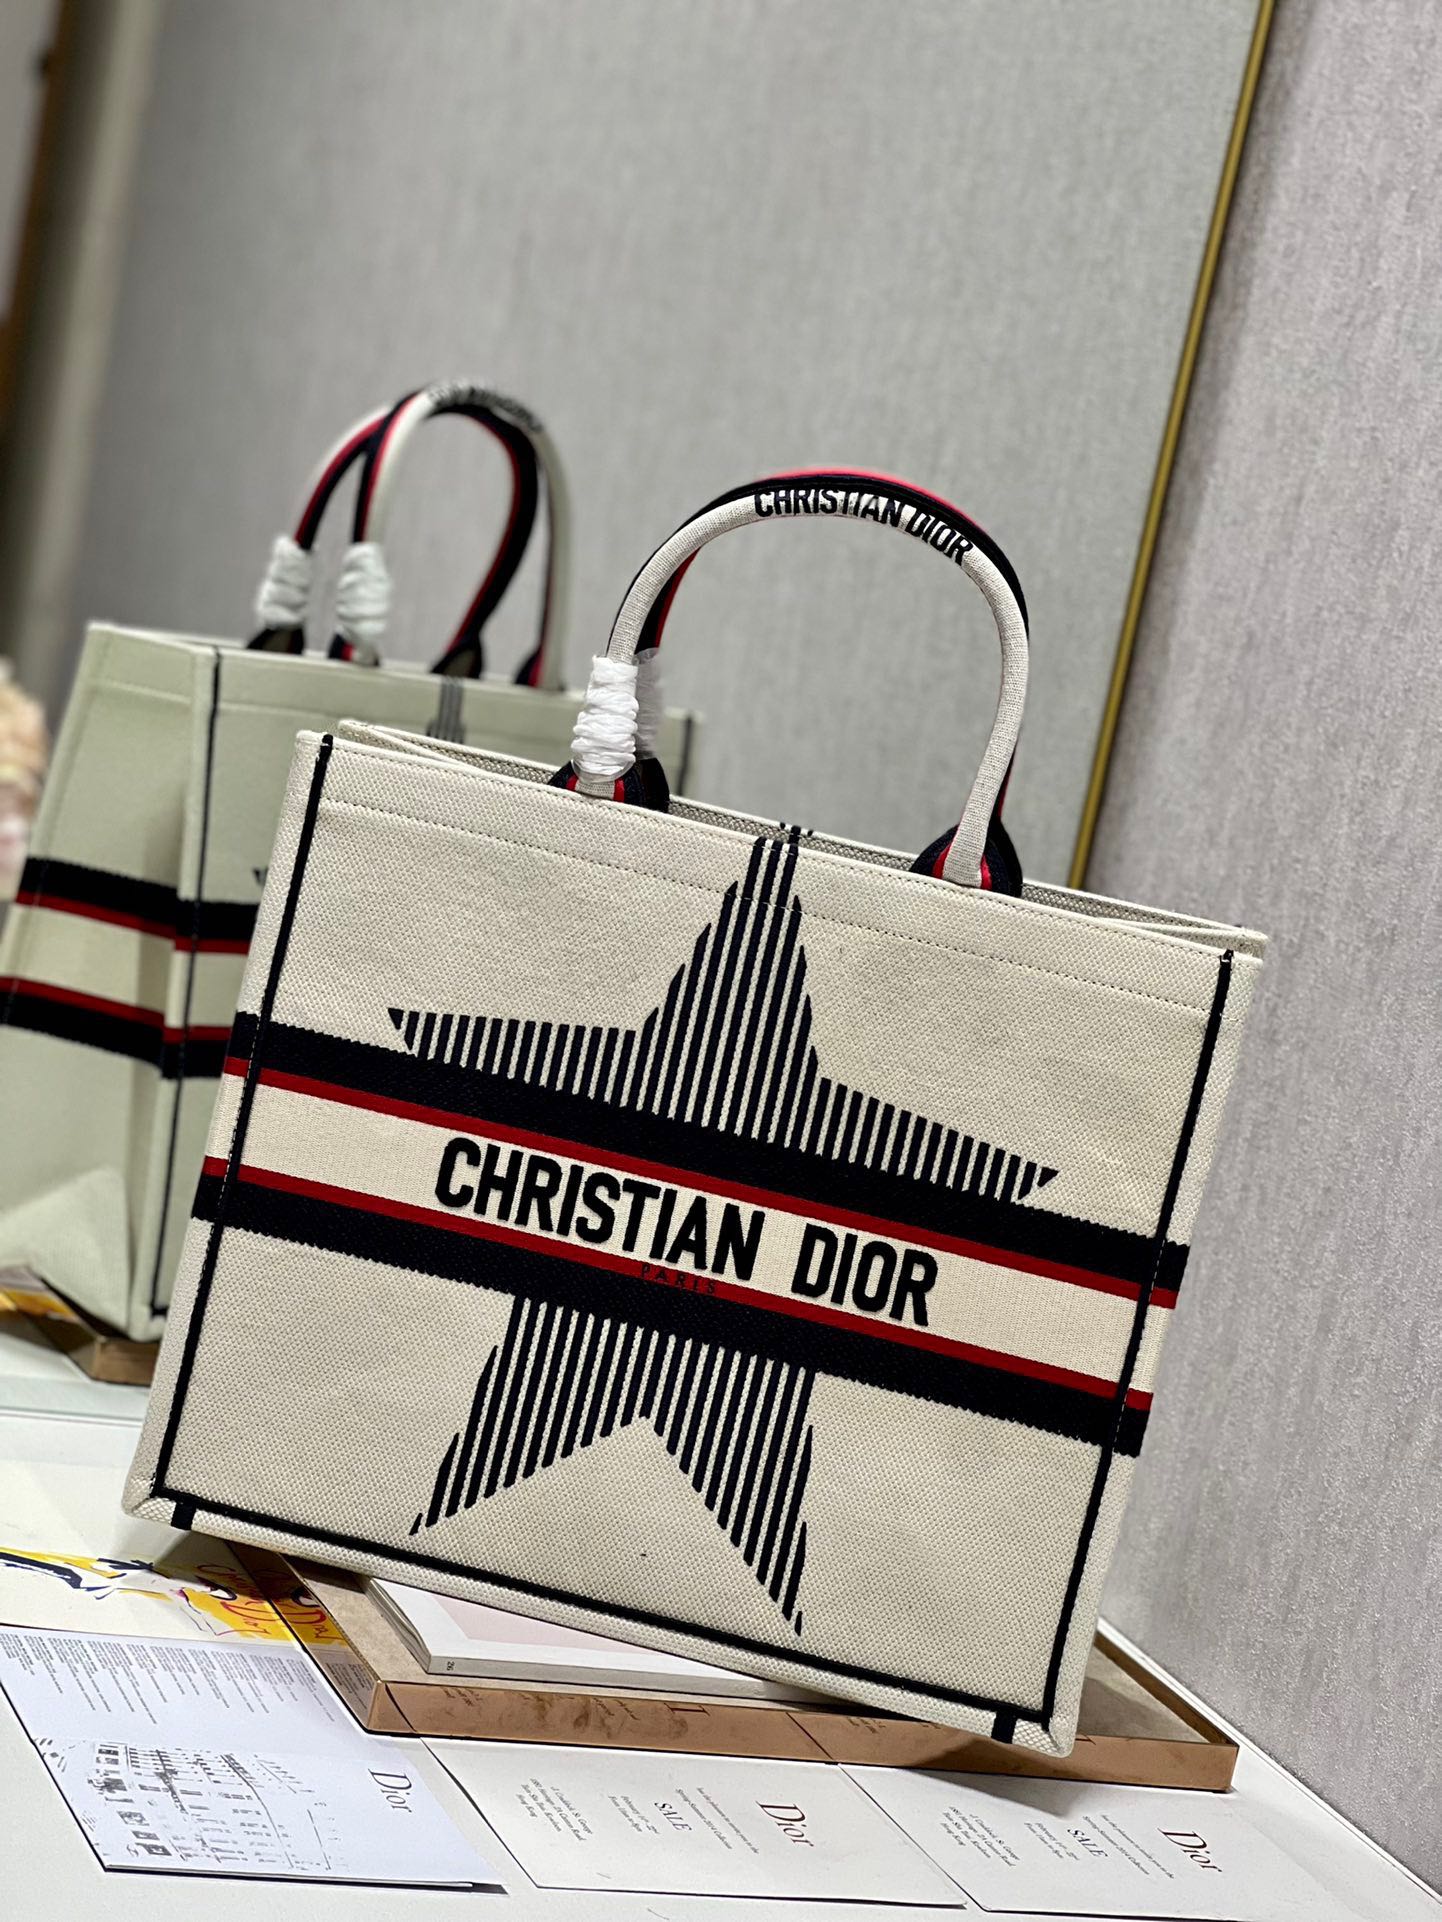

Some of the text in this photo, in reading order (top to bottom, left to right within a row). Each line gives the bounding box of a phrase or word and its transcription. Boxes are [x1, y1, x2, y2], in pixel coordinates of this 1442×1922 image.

[754, 488, 974, 566] CHRISTIAN DIOR
[434, 1137, 938, 1327] CHRISTIAN DIOR
[641, 1262, 716, 1295] PARIS
[368, 1768, 412, 1813] Dior
[654, 1802, 692, 1831] SALE
[755, 1800, 814, 1847] Dior
[1067, 1828, 1108, 1857] SALE
[1157, 1827, 1222, 1873] Dior
